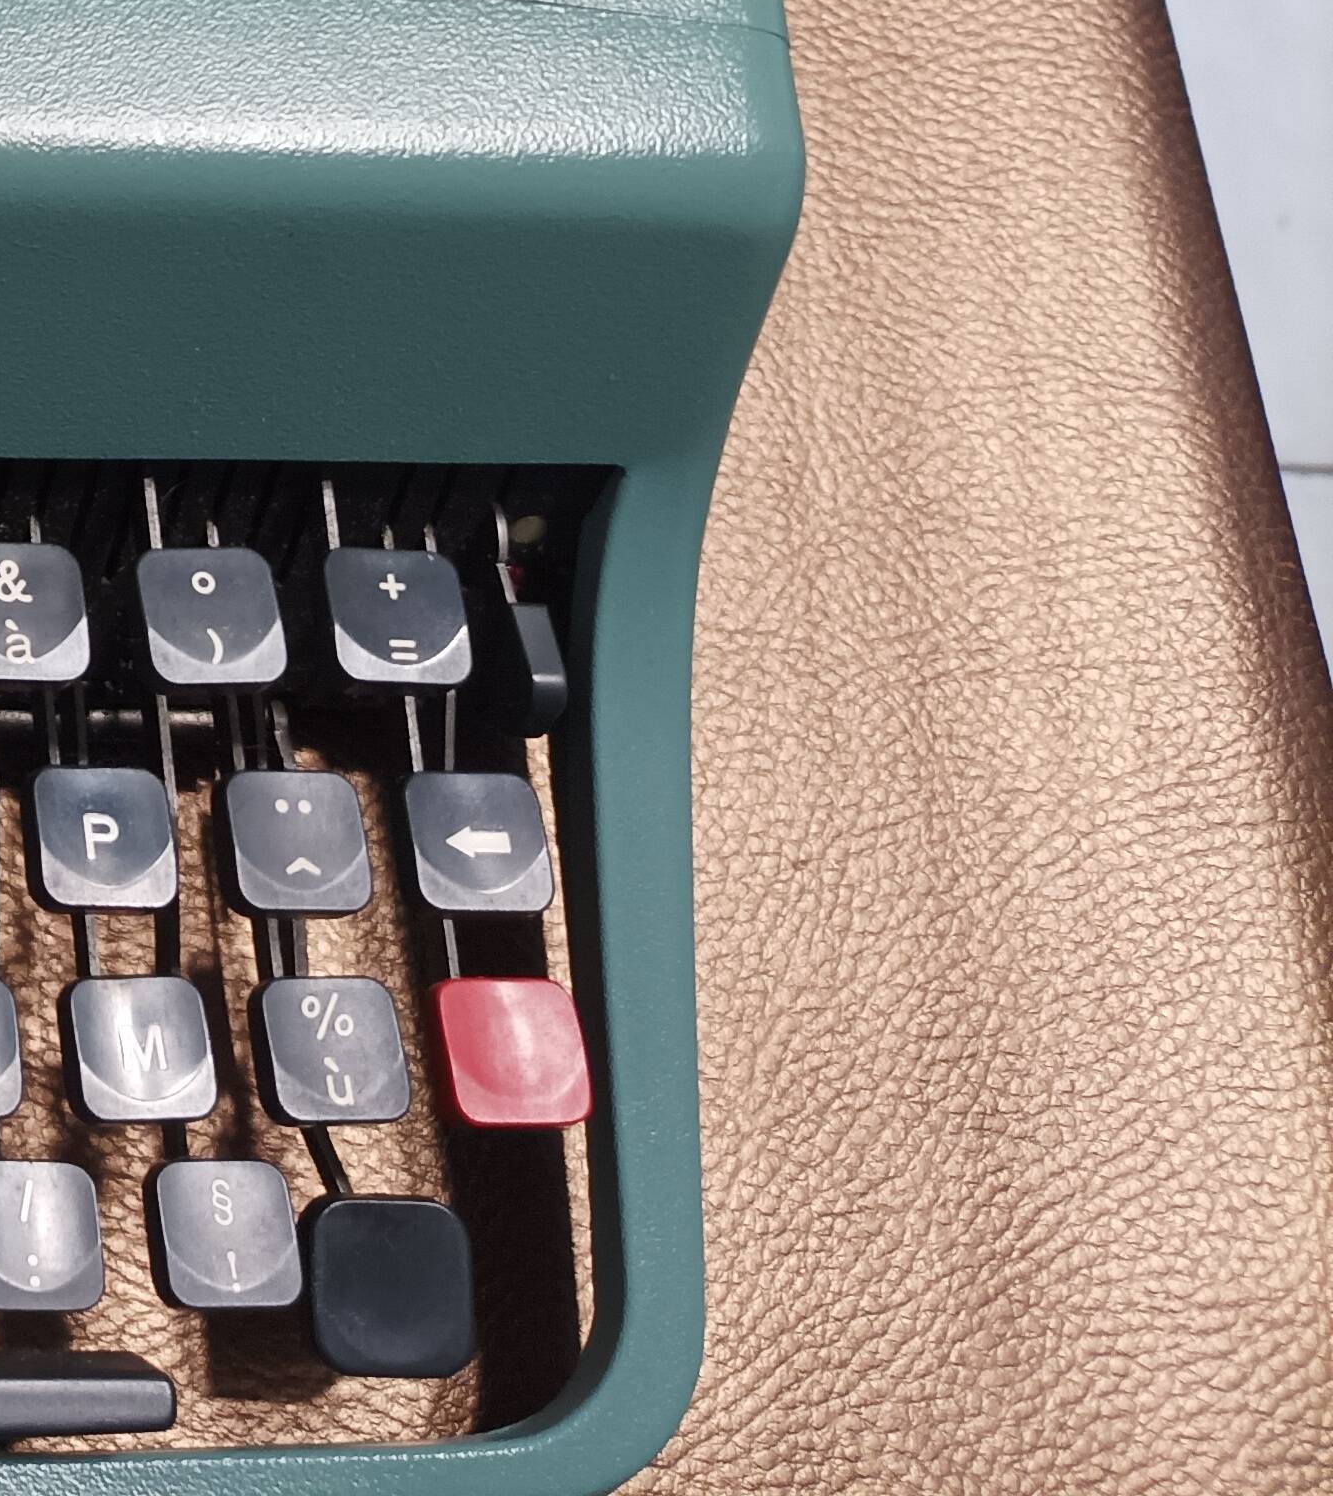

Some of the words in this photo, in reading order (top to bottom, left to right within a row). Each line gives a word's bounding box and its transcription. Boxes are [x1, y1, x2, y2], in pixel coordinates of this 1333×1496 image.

[4, 619, 34, 664] à
[83, 812, 119, 860] P
[301, 992, 354, 1040] %
[122, 1024, 167, 1072] M
[323, 1057, 353, 1107] ù
